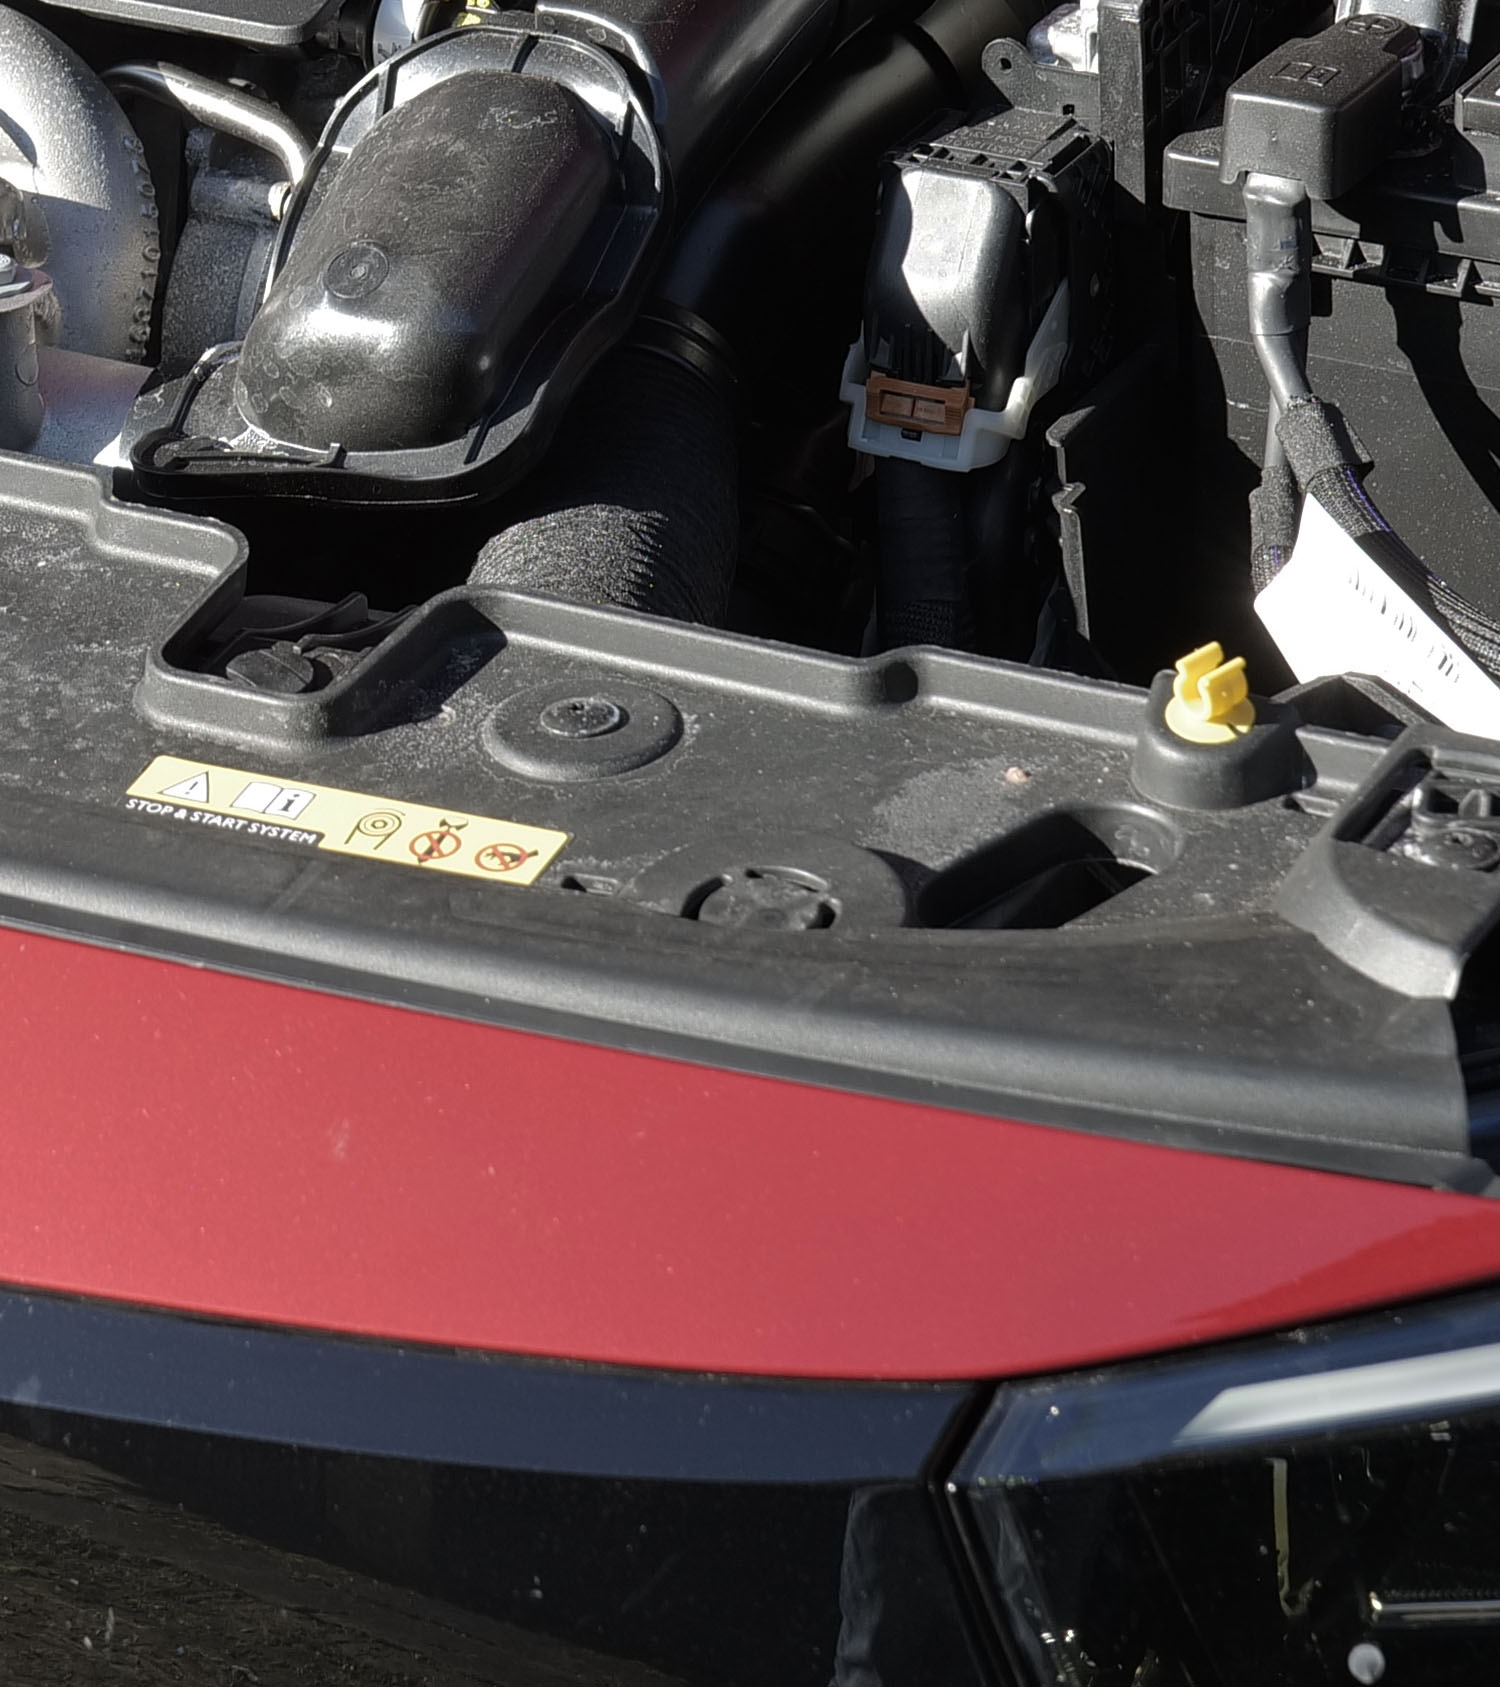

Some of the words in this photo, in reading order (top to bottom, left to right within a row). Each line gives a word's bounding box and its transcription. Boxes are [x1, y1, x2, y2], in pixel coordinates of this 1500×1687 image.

[125, 798, 174, 816] STOP
[175, 808, 188, 820] &
[189, 812, 245, 832] START
[247, 822, 318, 845] SYSTEM
